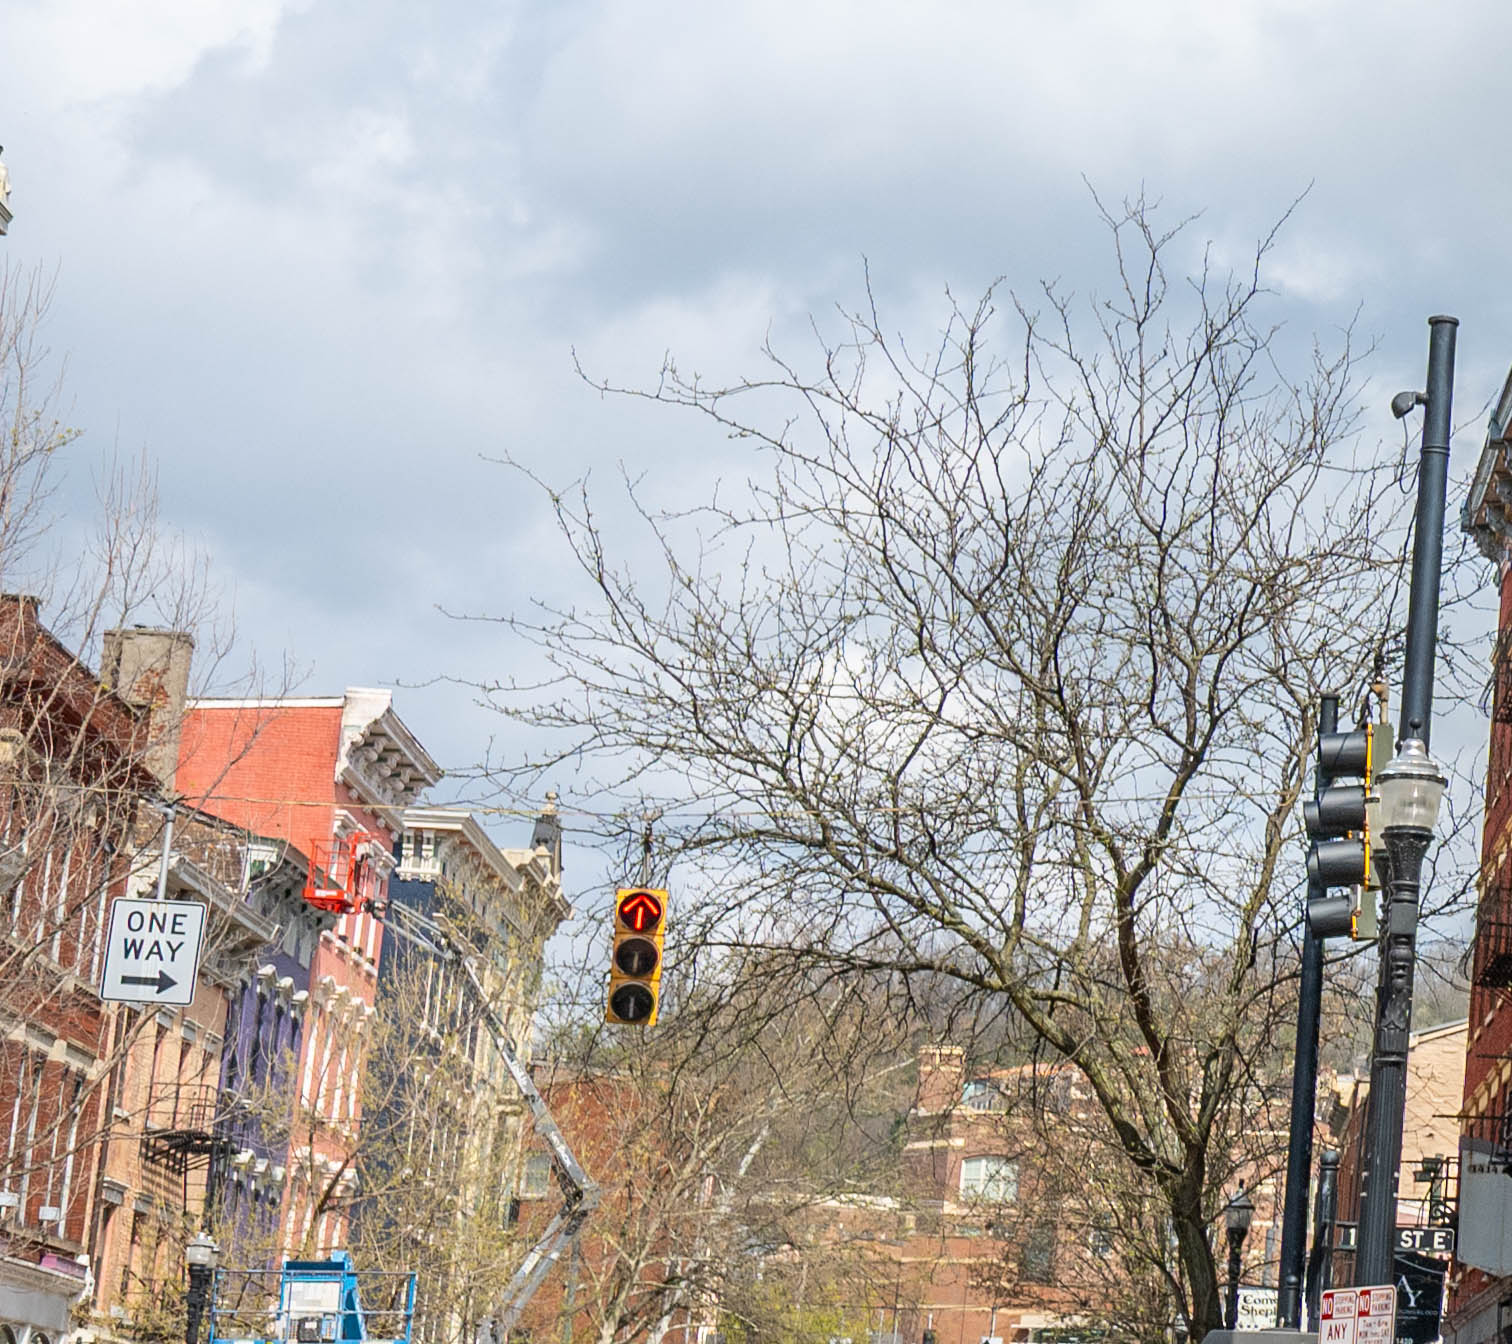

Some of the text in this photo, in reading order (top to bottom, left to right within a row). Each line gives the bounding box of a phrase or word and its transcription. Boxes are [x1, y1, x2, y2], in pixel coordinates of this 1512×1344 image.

[127, 910, 188, 935] ONE
[123, 937, 185, 962] WAY
[1400, 1230, 1446, 1249] ST E
[1322, 1297, 1333, 1316] NO
[1359, 1294, 1370, 1313] NO
[1327, 1322, 1347, 1341] ANY
